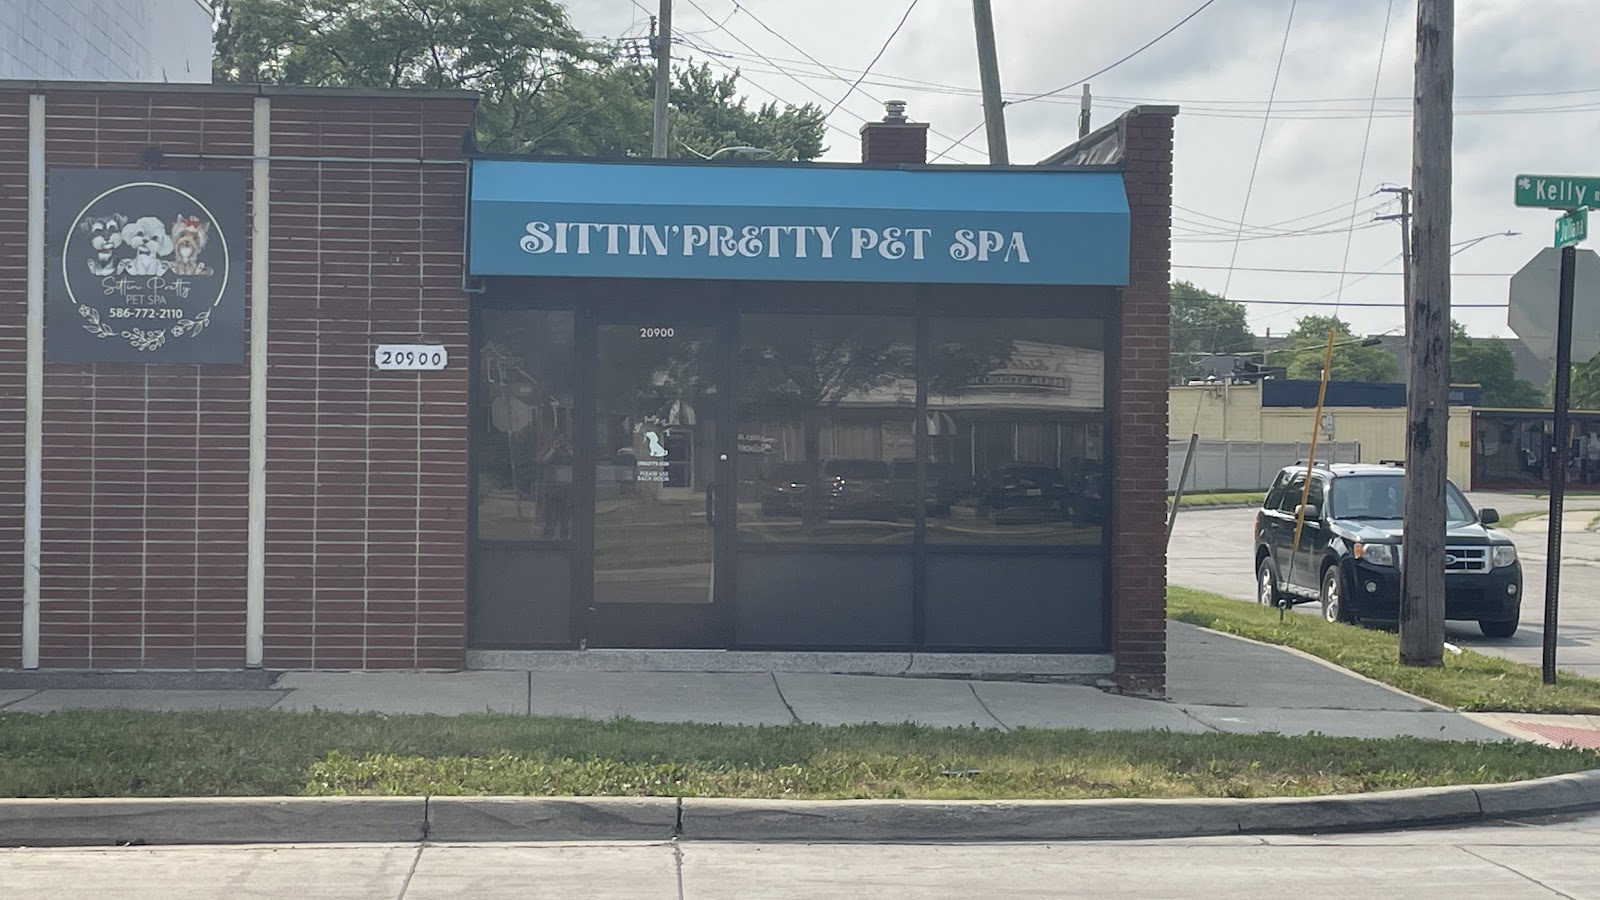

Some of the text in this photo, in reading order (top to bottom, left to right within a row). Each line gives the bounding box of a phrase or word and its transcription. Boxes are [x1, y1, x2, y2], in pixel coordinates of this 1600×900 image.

[1536, 180, 1587, 205] Kelly
[850, 226, 932, 261] PET
[949, 229, 1031, 264] SPA
[125, 294, 168, 305] PET SPA
[109, 307, 183, 318] 586-772-2110
[640, 327, 675, 338] 20900
[381, 351, 442, 367] 20900
